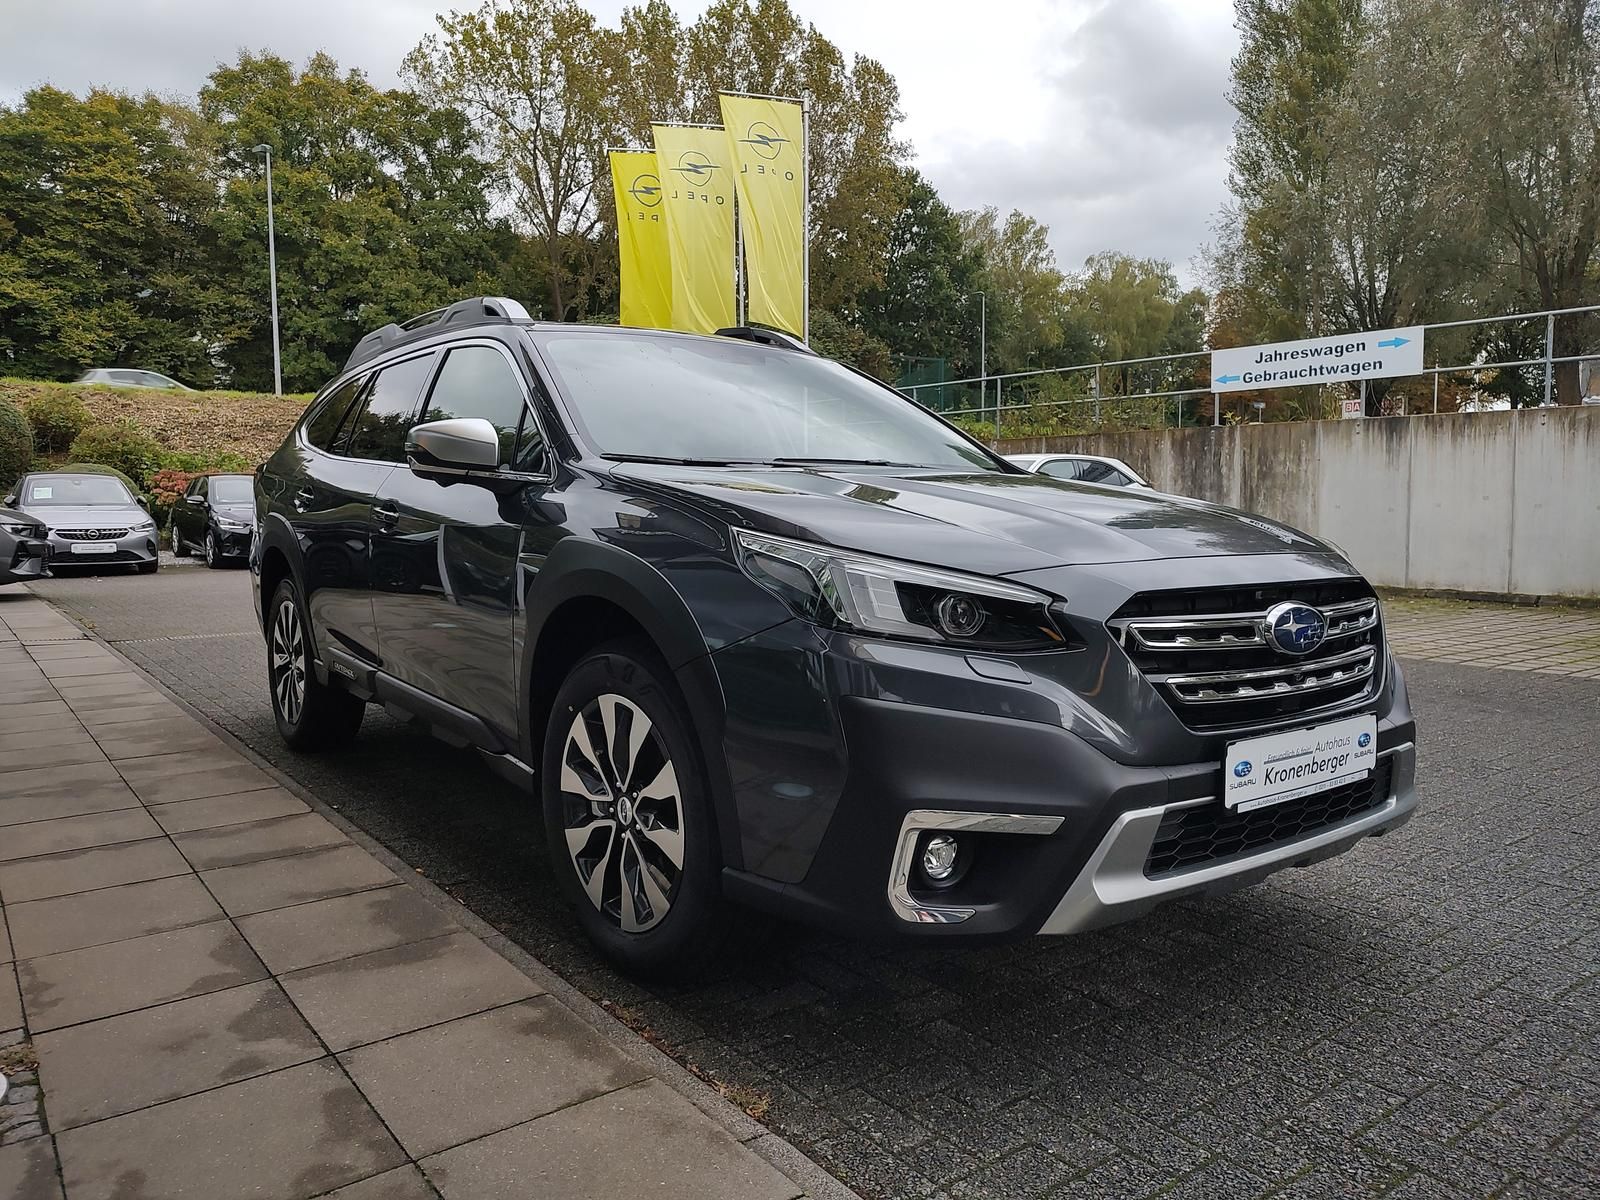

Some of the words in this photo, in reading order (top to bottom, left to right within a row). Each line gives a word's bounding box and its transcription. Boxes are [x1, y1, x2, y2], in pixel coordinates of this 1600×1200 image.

[1254, 341, 1366, 364] Jahreswagen
[1242, 359, 1383, 384] Gebrauchtwagen
[1314, 736, 1351, 753] Autohaus
[1353, 748, 1375, 759] SUBARU
[1263, 752, 1351, 787] Kronenberger
[1229, 778, 1257, 791] SUBARU
